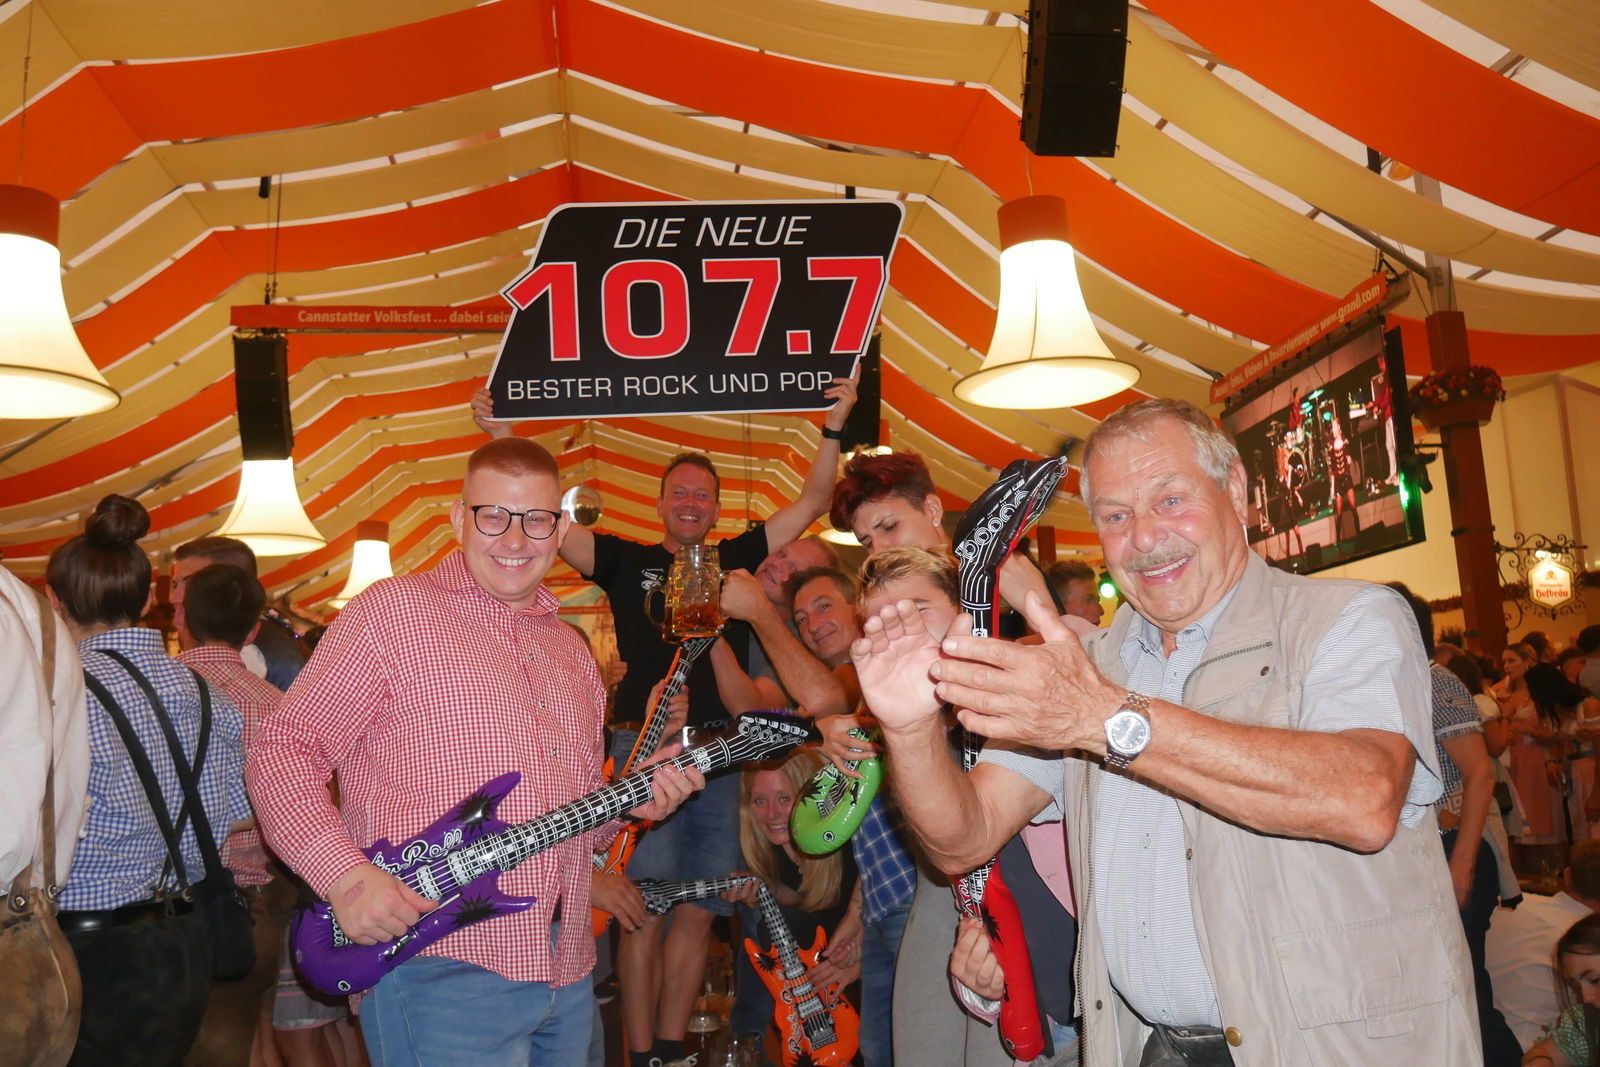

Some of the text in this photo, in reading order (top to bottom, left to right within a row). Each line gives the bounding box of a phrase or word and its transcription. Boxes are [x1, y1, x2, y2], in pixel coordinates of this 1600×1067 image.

[613, 215, 812, 249] DIE NEUE
[297, 310, 372, 323] Cannstatter
[449, 310, 484, 323] dabei
[506, 256, 884, 361] 107.7
[507, 371, 833, 400] BESTER ROCK UND POP
